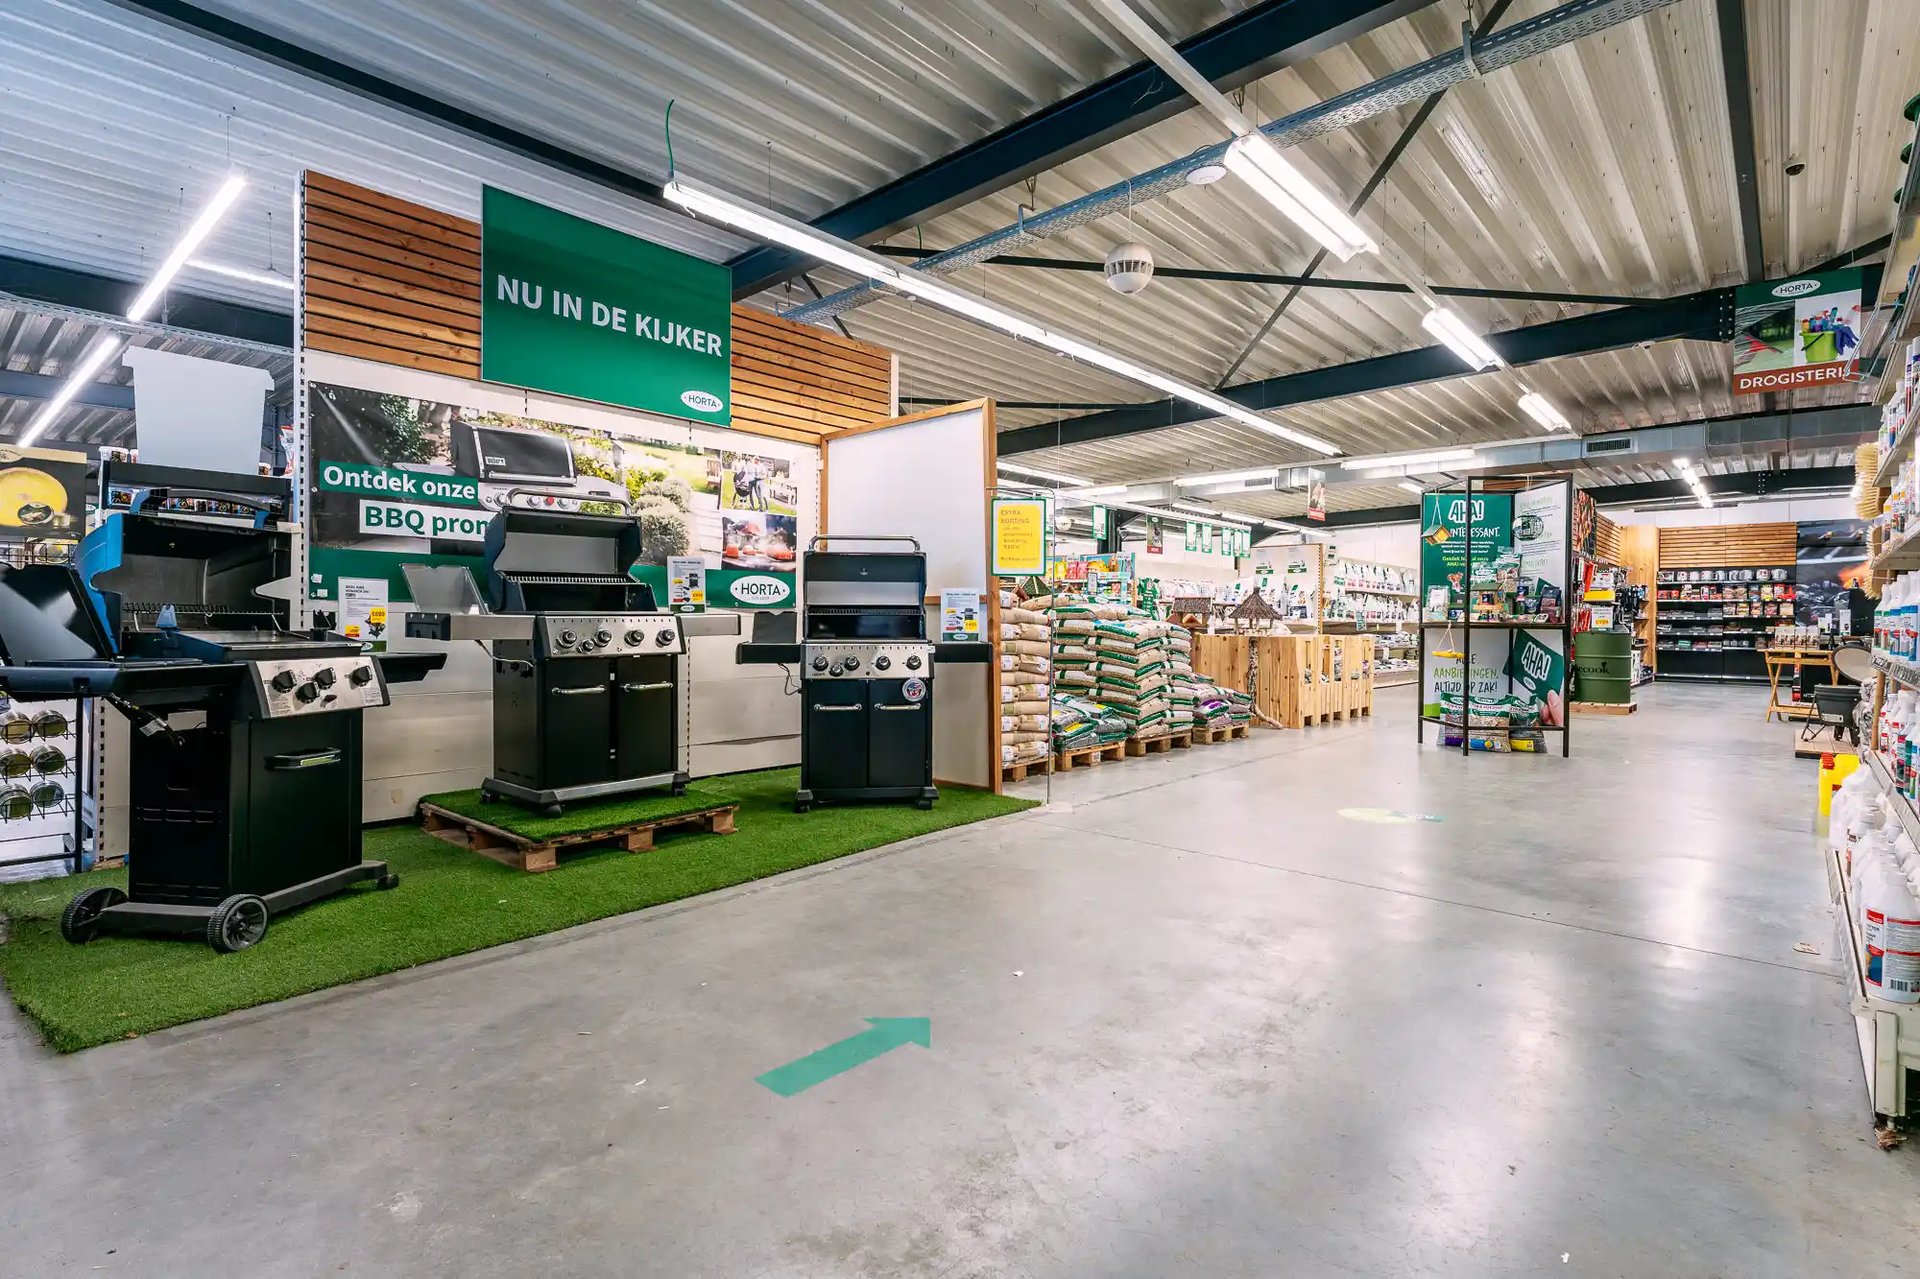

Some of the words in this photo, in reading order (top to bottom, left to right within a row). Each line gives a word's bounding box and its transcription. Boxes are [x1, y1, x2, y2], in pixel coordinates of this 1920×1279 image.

[1780, 282, 1814, 294] HORTA
[497, 274, 543, 310] NU
[553, 290, 582, 321] IN
[592, 301, 627, 332] DE
[635, 313, 723, 357] KIJKER
[1739, 367, 1847, 389] DROGISTERI
[688, 395, 717, 407] HORTA
[323, 465, 417, 494] Ontdek
[422, 480, 476, 500] onze
[365, 506, 426, 535] BBQ
[741, 583, 781, 595] HORTA
[1521, 641, 1552, 681] AHA!
[1434, 681, 1462, 693] ALTIJD
[1478, 681, 1498, 693] ZAK!
